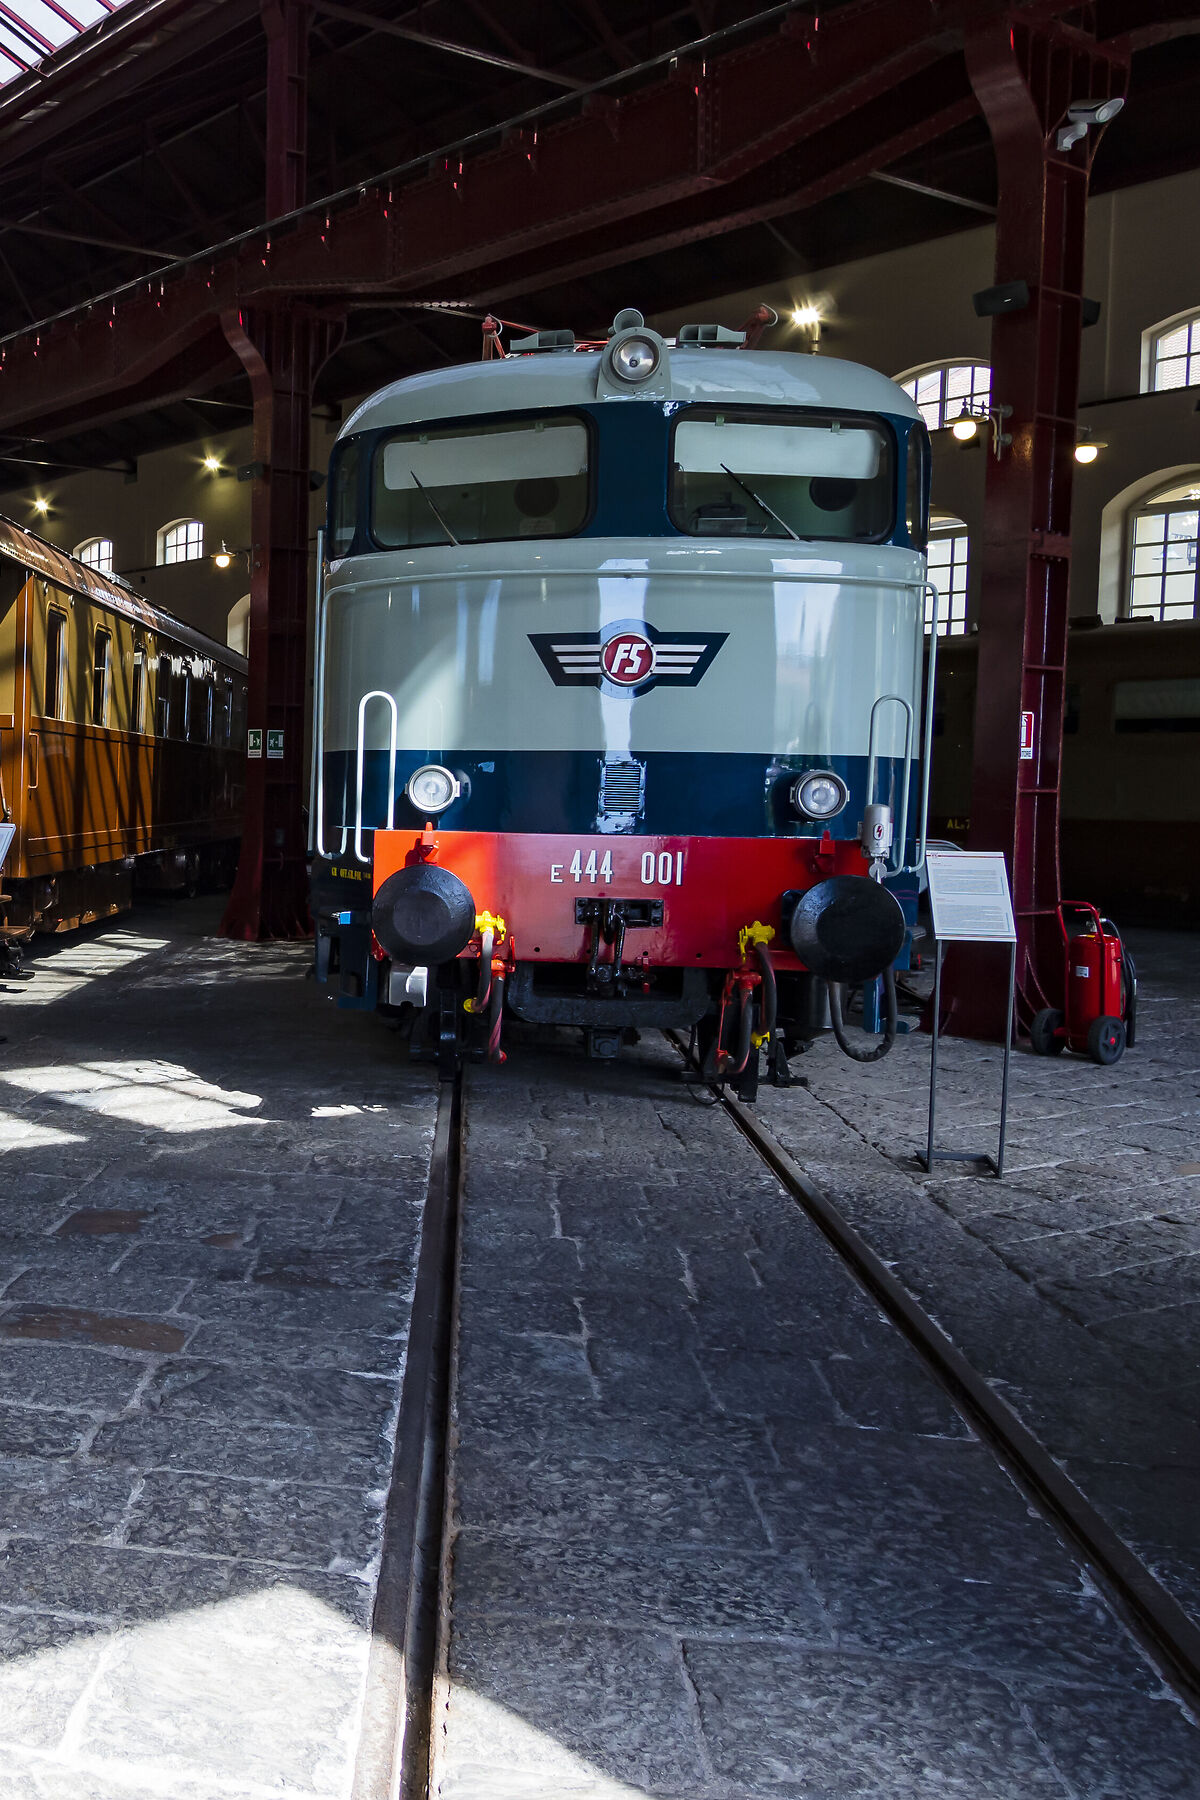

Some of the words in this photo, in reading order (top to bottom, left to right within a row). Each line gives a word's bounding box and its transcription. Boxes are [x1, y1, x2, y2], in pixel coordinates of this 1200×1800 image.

[610, 643, 647, 674] FS
[550, 864, 564, 883] E
[569, 849, 614, 883] 444
[640, 851, 683, 886] 001
